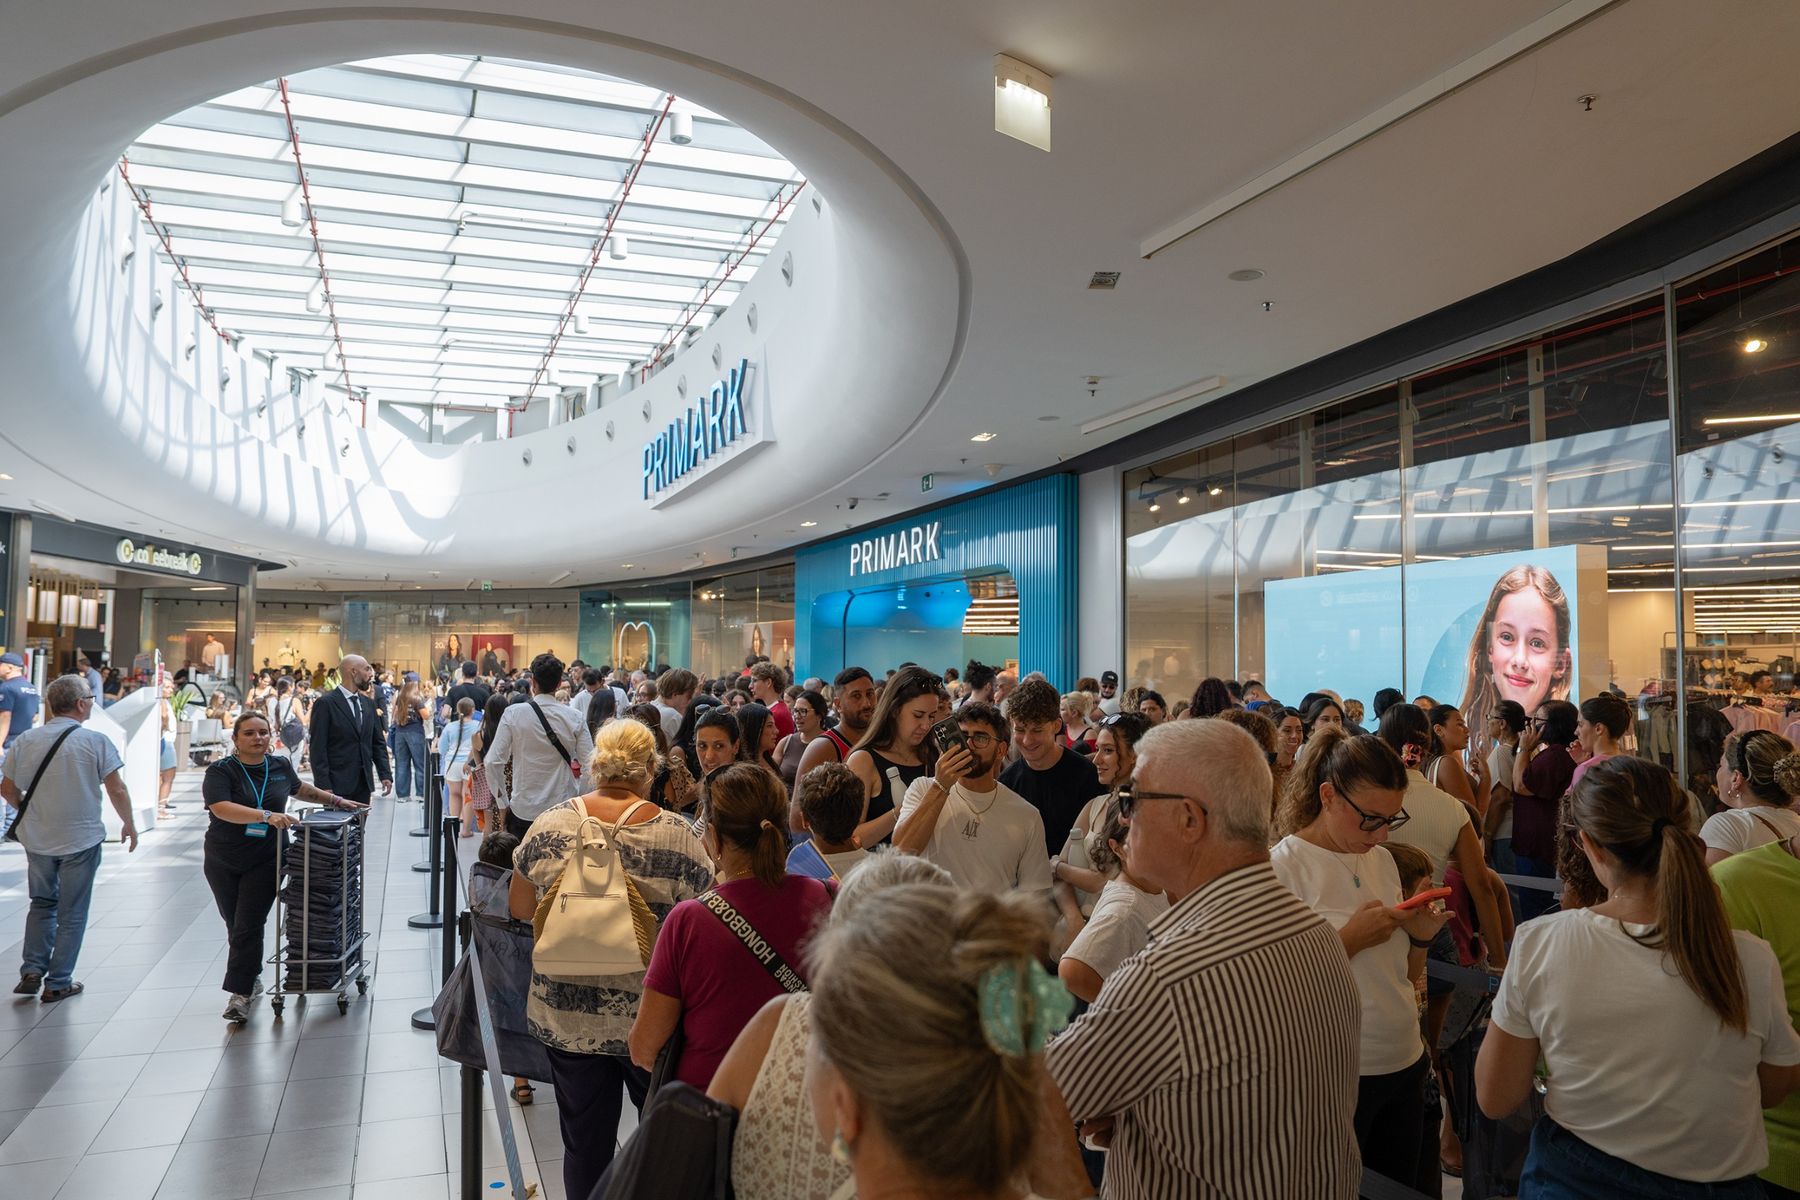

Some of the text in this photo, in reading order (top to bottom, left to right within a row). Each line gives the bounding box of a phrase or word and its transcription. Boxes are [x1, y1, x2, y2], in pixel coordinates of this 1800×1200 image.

[642, 358, 748, 500] PRIMARK
[850, 522, 938, 576] PRIMARK
[780, 963, 809, 993] ASHION
